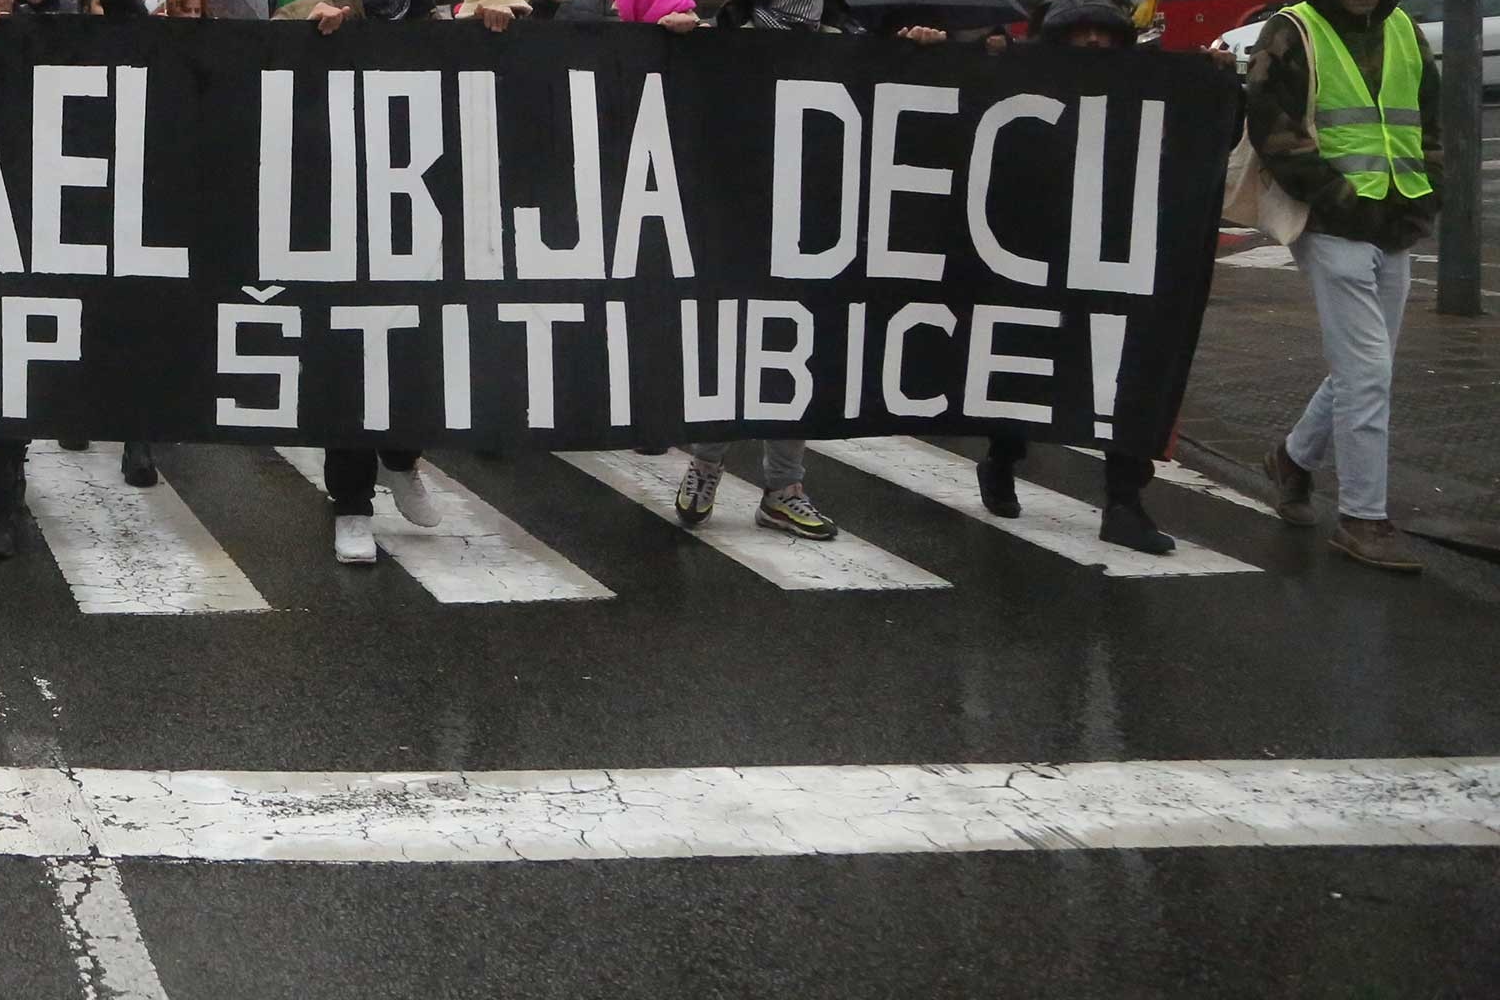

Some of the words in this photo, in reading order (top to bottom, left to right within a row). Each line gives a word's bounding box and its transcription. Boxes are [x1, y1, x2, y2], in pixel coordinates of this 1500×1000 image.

[258, 68, 696, 281] UBIJA
[770, 79, 1166, 296] DECU
[216, 285, 633, 430] ŠTITI
[681, 299, 1127, 440] UBICE!
